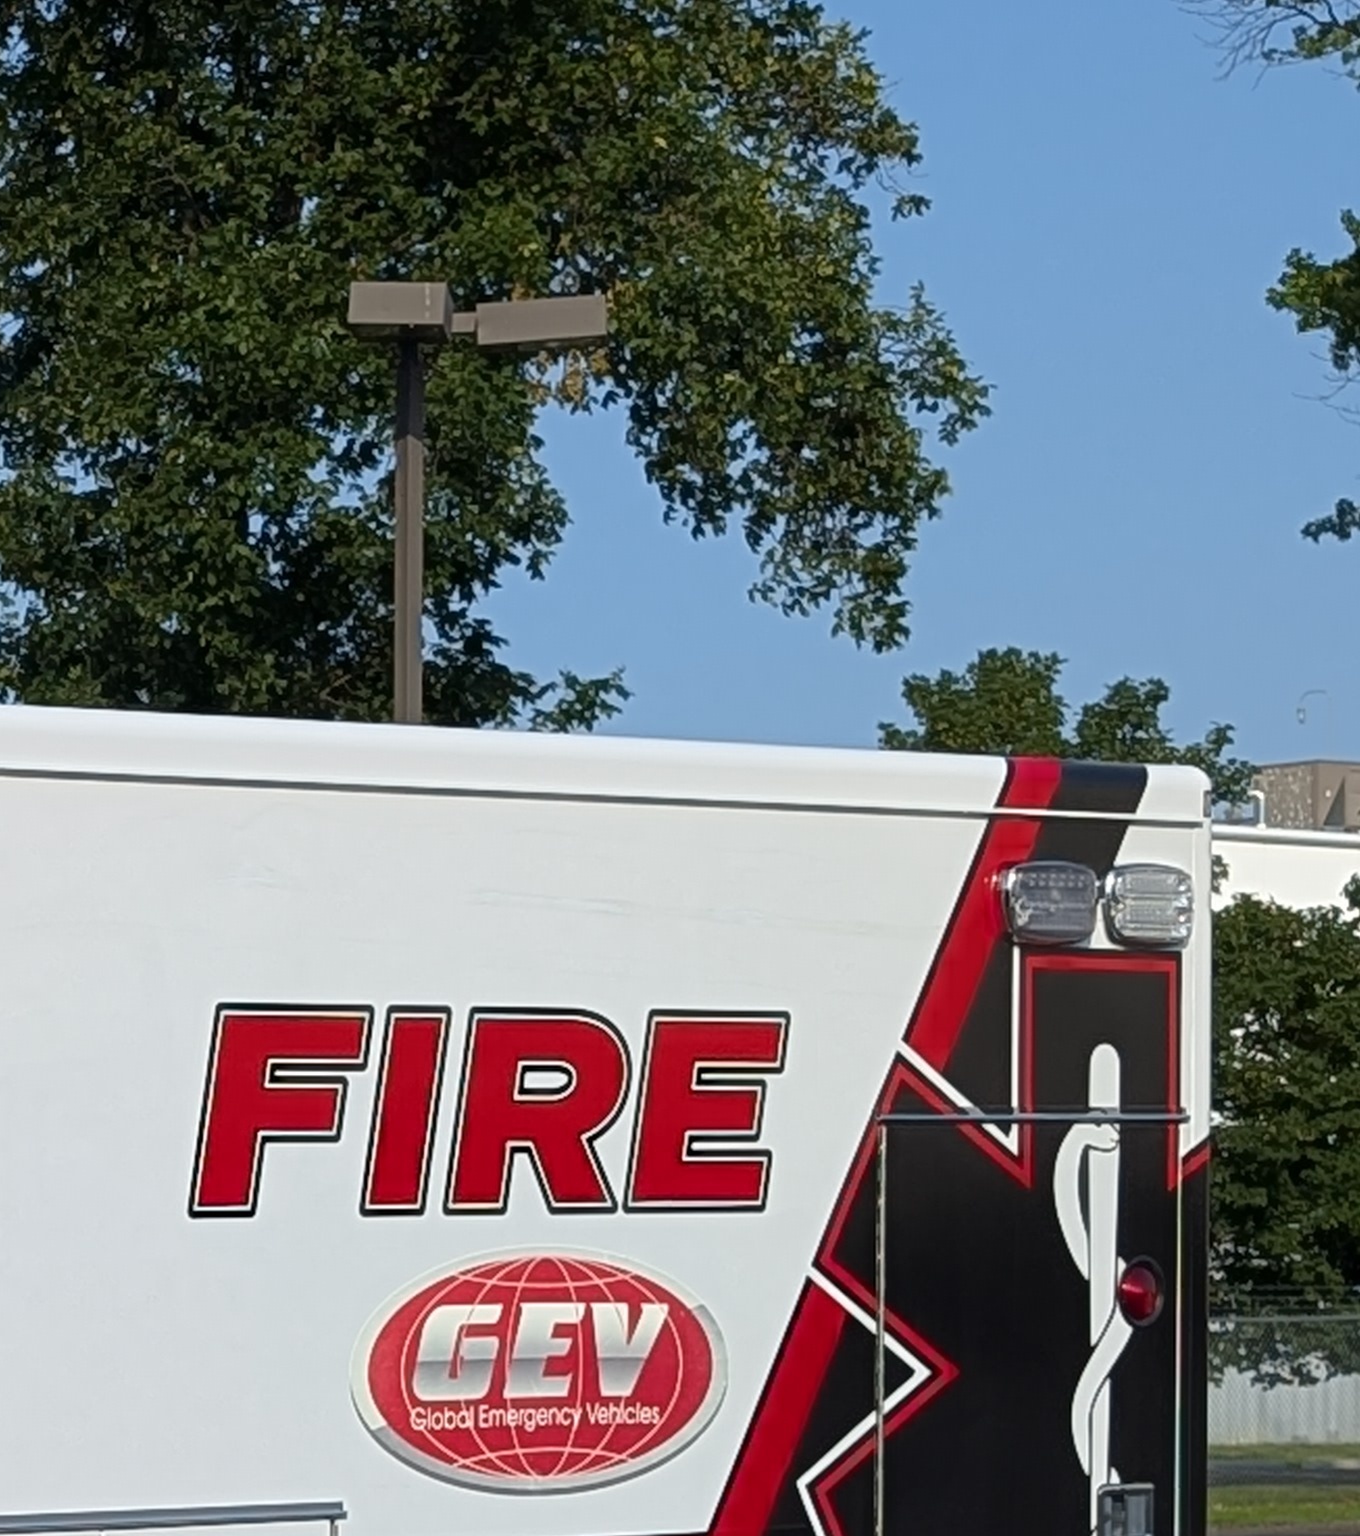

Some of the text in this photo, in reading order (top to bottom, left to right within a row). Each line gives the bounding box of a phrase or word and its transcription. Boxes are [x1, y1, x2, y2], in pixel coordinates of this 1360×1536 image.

[188, 1002, 791, 1218] FIRE
[411, 1302, 670, 1401] GEV
[410, 1401, 660, 1432] Global Emergency Vehicles
